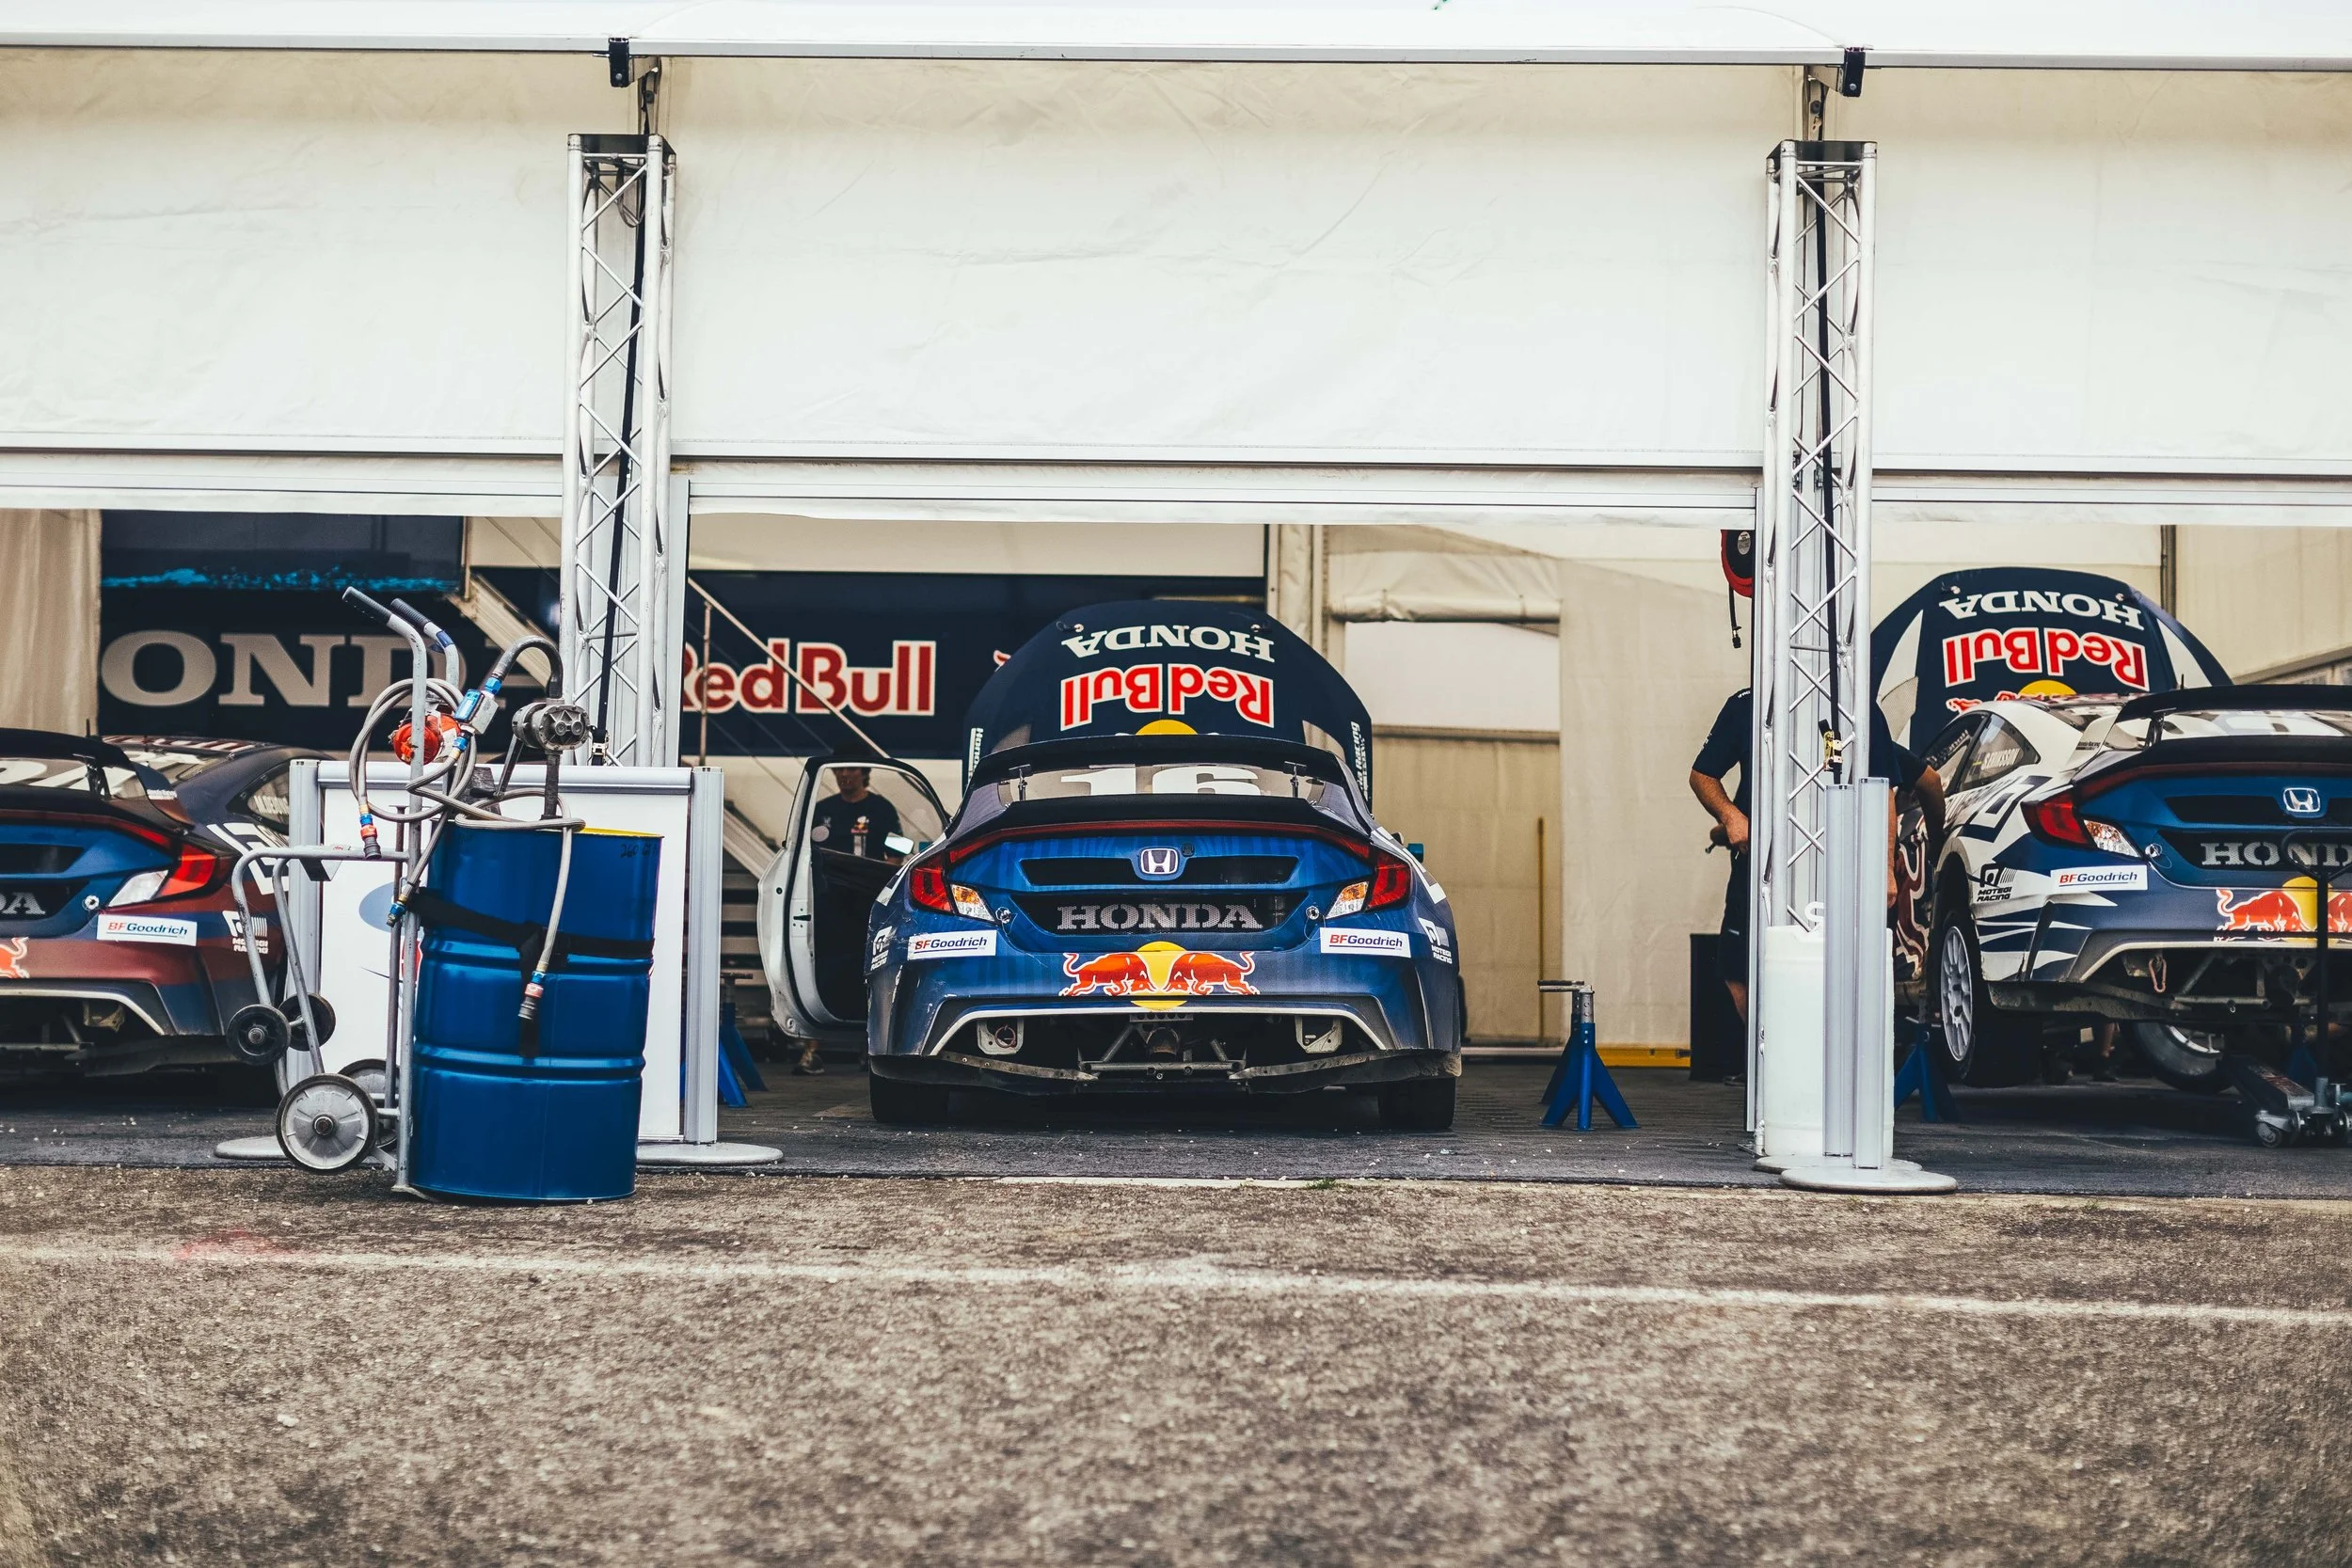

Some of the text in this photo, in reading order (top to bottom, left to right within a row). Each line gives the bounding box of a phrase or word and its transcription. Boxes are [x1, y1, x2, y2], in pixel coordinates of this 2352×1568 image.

[1939, 590, 2145, 630] HONDA
[1061, 625, 1275, 662] HONDA
[101, 630, 540, 707] OND
[1060, 765, 1262, 795] 16
[2059, 871, 2138, 885] BFGoodrich
[1976, 893, 2011, 903] RACING
[1977, 886, 2012, 896] MOTEGI
[1057, 903, 1263, 930] HONDA
[107, 921, 189, 936] BFGoodrich
[1329, 933, 1404, 948] BFGoodrich
